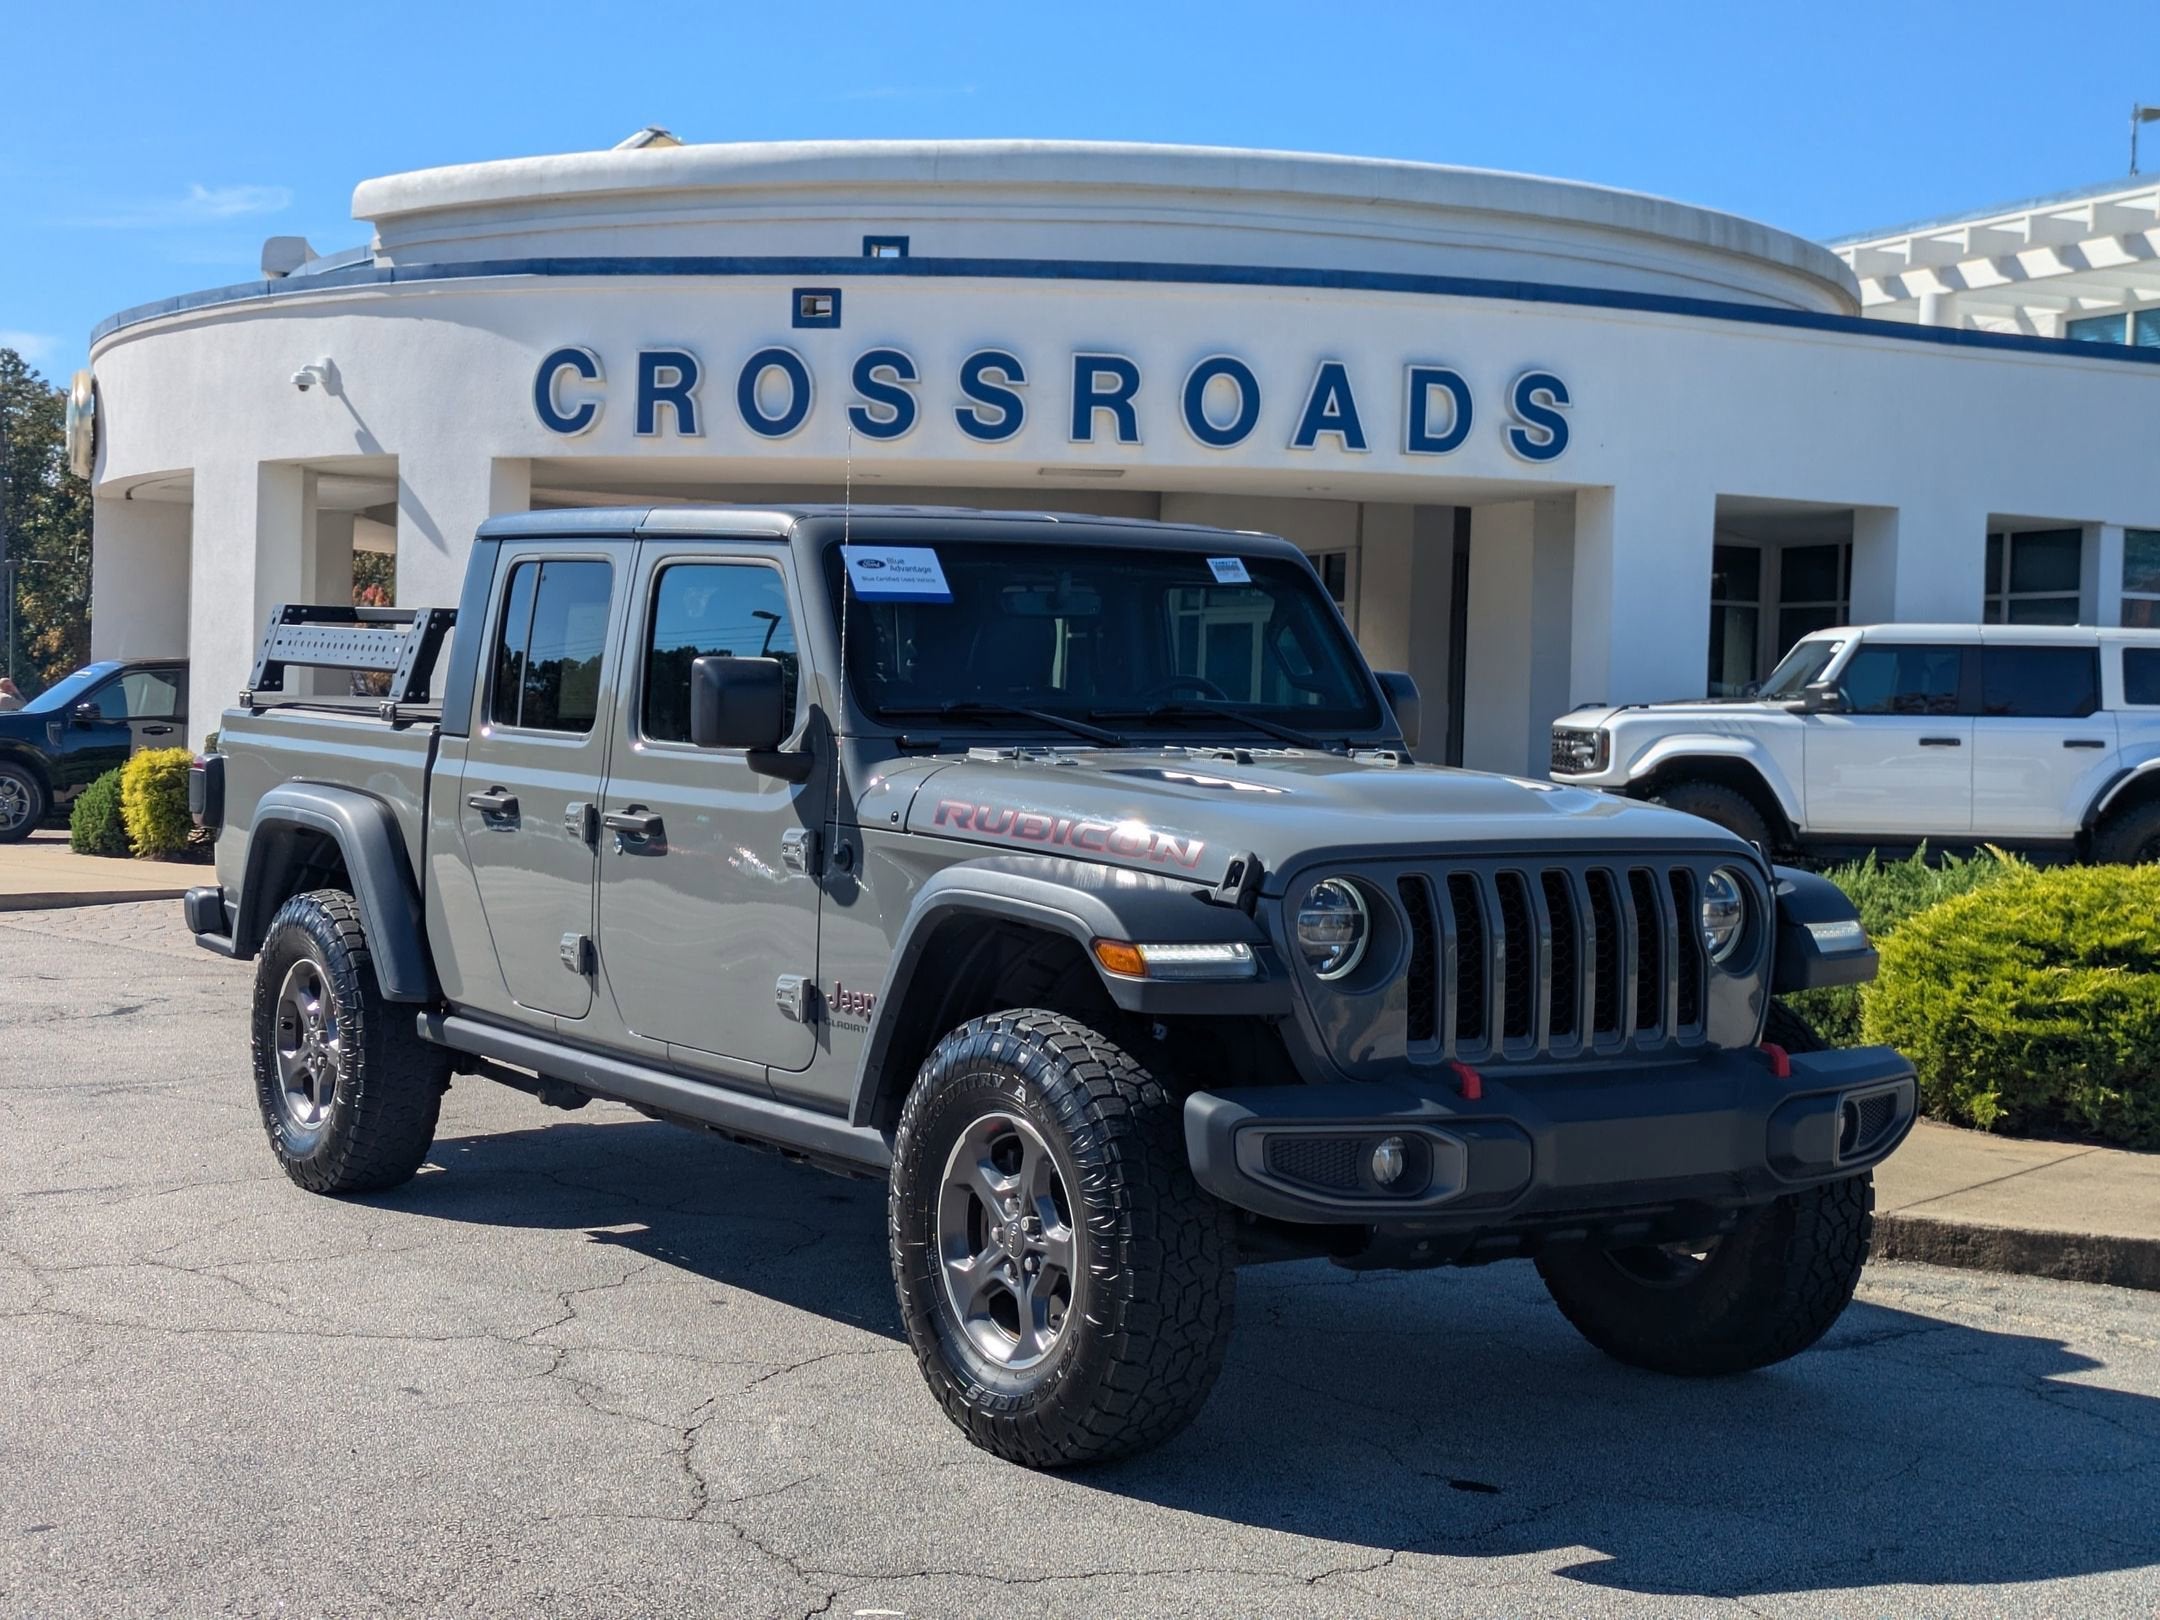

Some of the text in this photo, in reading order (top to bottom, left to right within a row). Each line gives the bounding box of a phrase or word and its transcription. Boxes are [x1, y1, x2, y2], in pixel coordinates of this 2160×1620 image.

[532, 345, 1573, 463] CROSSROADS
[890, 564, 932, 575] Advantage
[933, 799, 1205, 870] RUBICON
[825, 980, 877, 1024] Jeep
[966, 1383, 1037, 1413] TIRES
